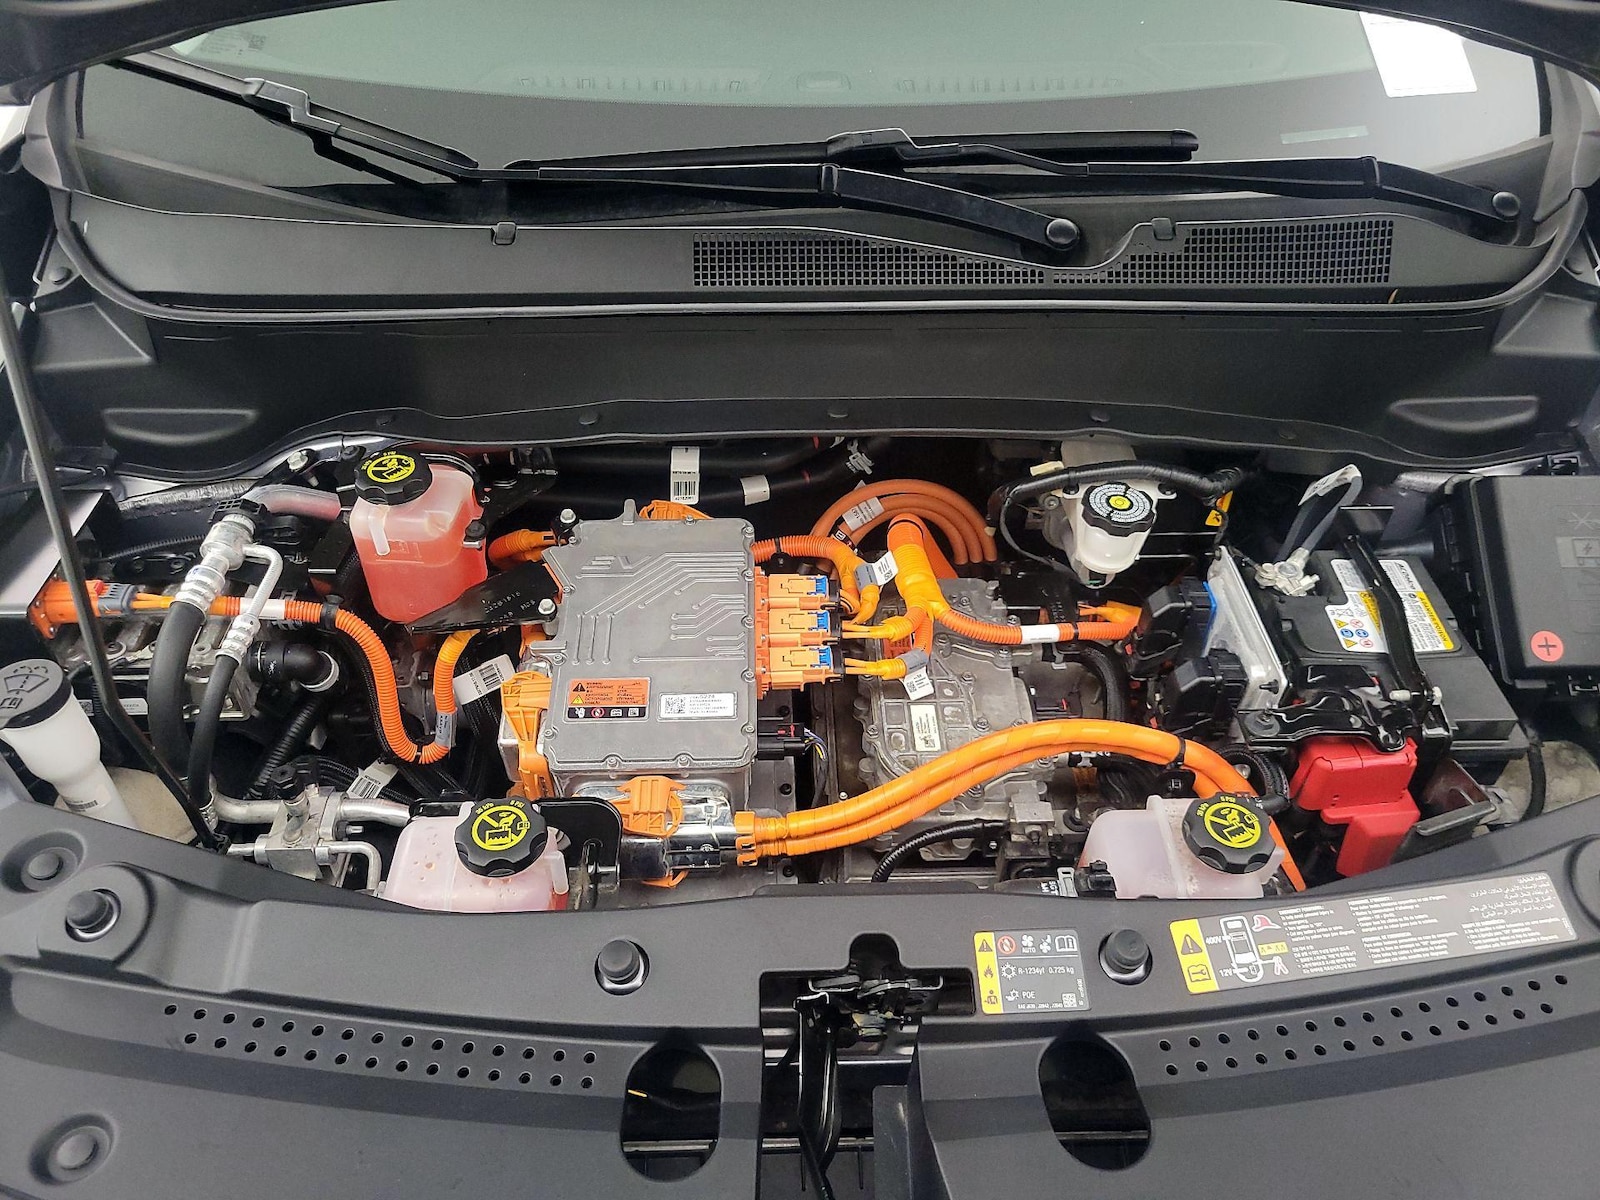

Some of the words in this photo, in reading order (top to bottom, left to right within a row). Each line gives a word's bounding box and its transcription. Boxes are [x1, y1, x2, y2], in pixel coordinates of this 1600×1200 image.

[1048, 966, 1065, 974] 0.725
[1066, 966, 1074, 975] kg
[1219, 968, 1233, 977] 12V
[1022, 991, 1036, 999] POE
